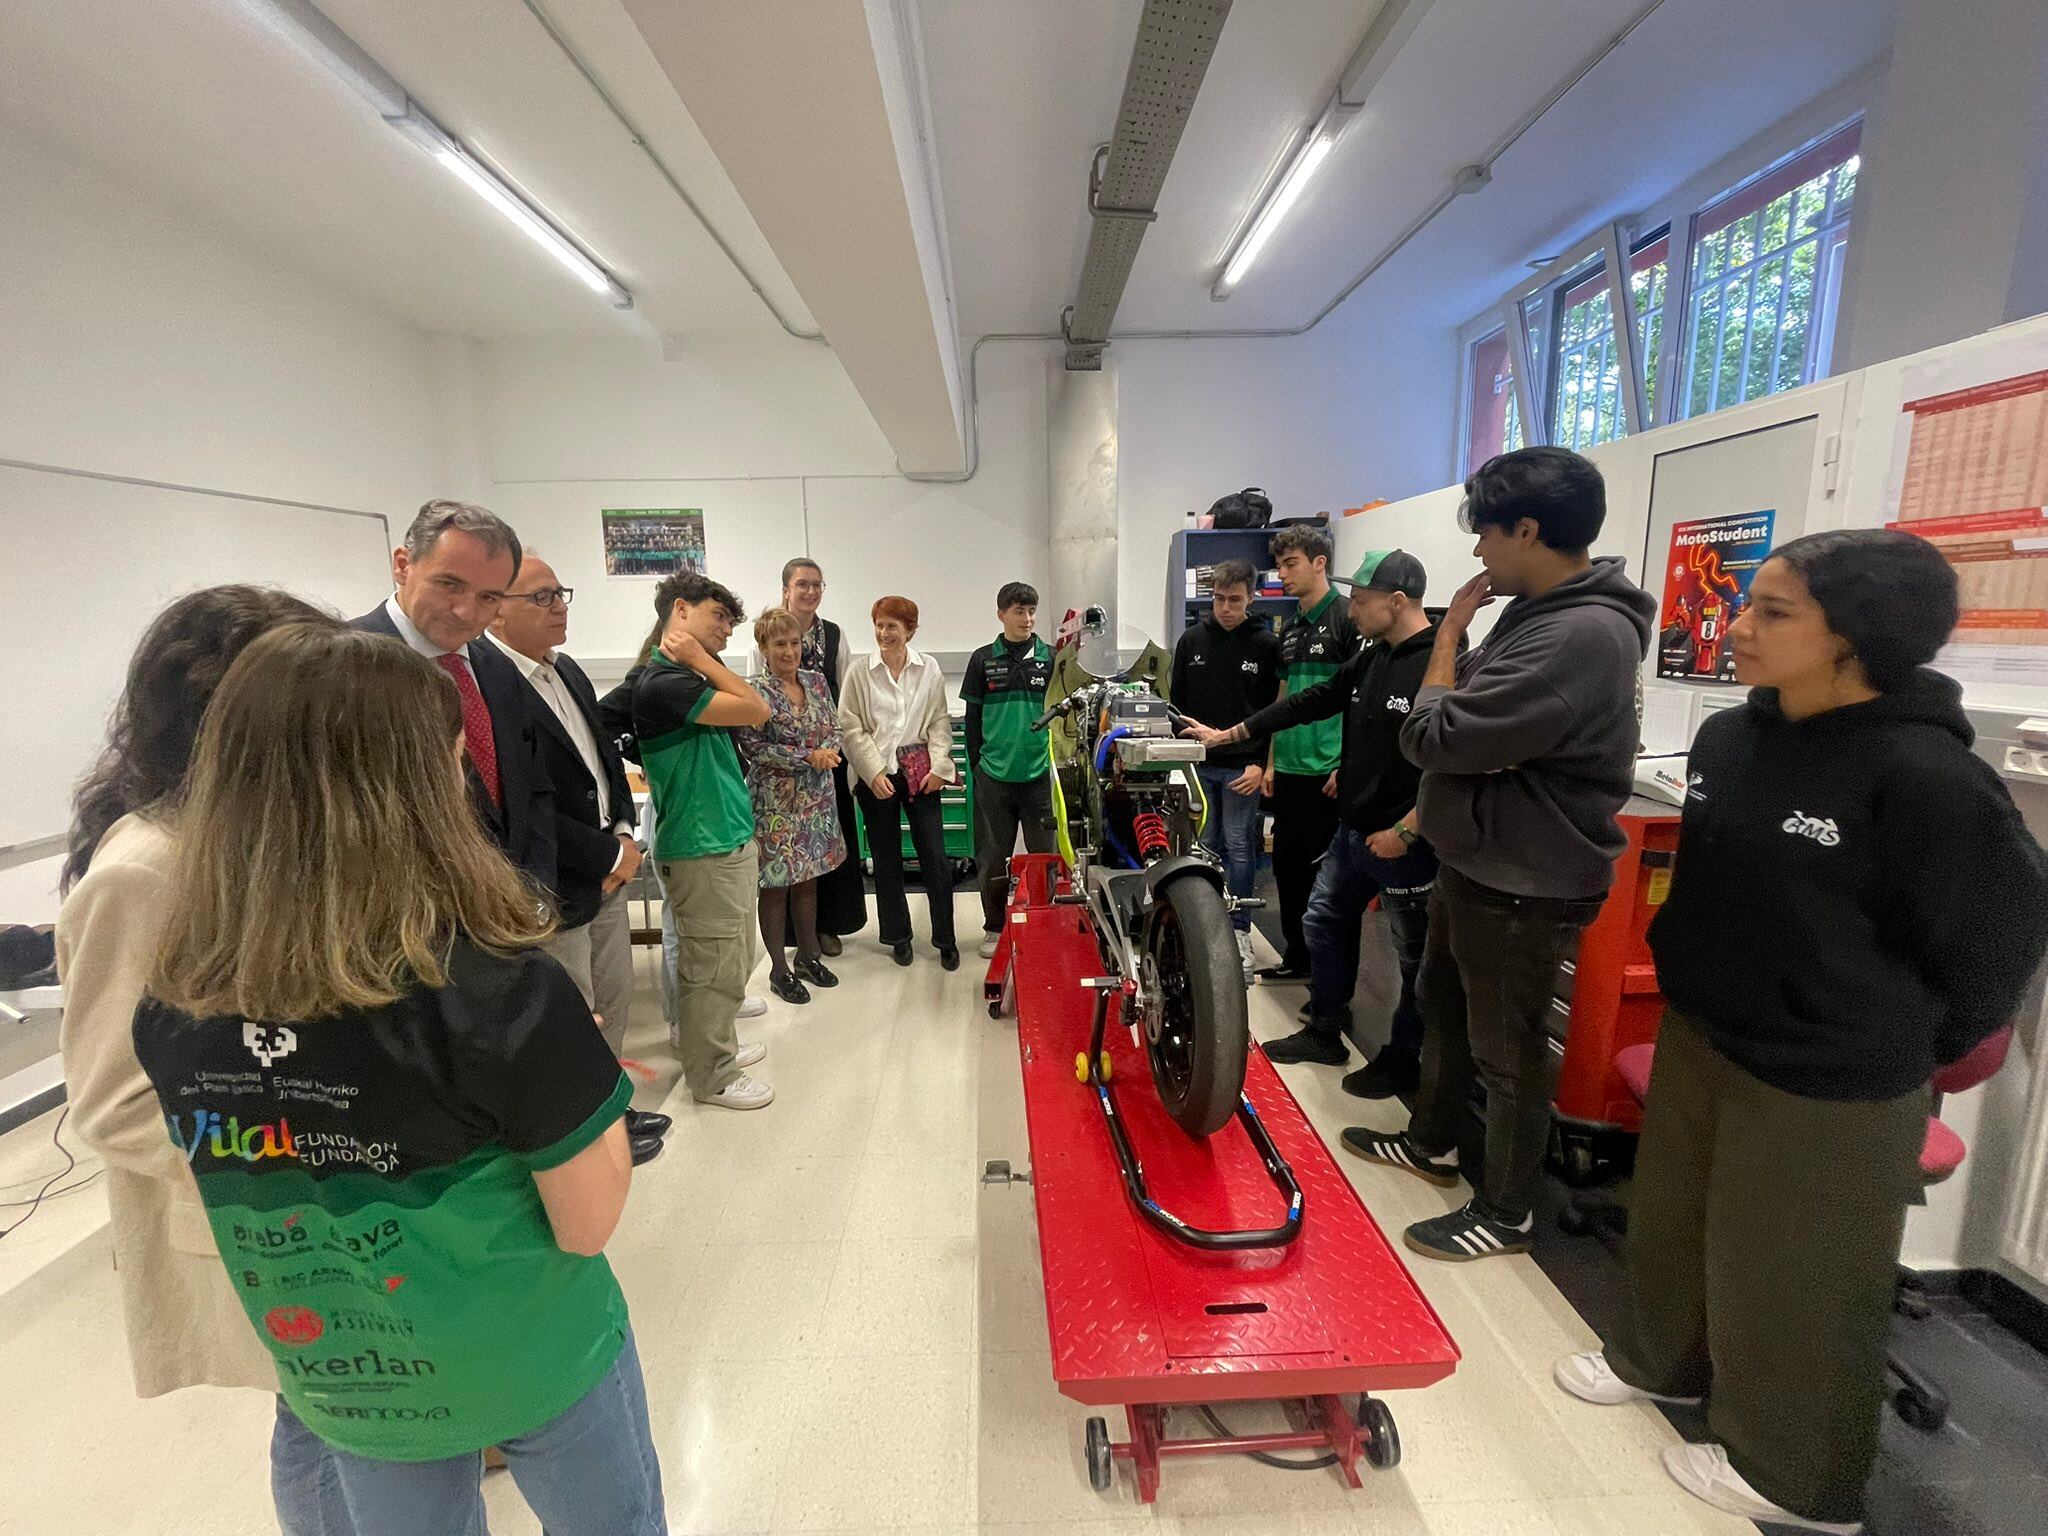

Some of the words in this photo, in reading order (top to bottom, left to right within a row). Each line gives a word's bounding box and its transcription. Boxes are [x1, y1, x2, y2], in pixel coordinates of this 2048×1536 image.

[1676, 525, 1768, 546] MotoStudent
[315, 1080, 359, 1096] Hrriko
[171, 1109, 298, 1161] Vital
[234, 1224, 307, 1247] aaba
